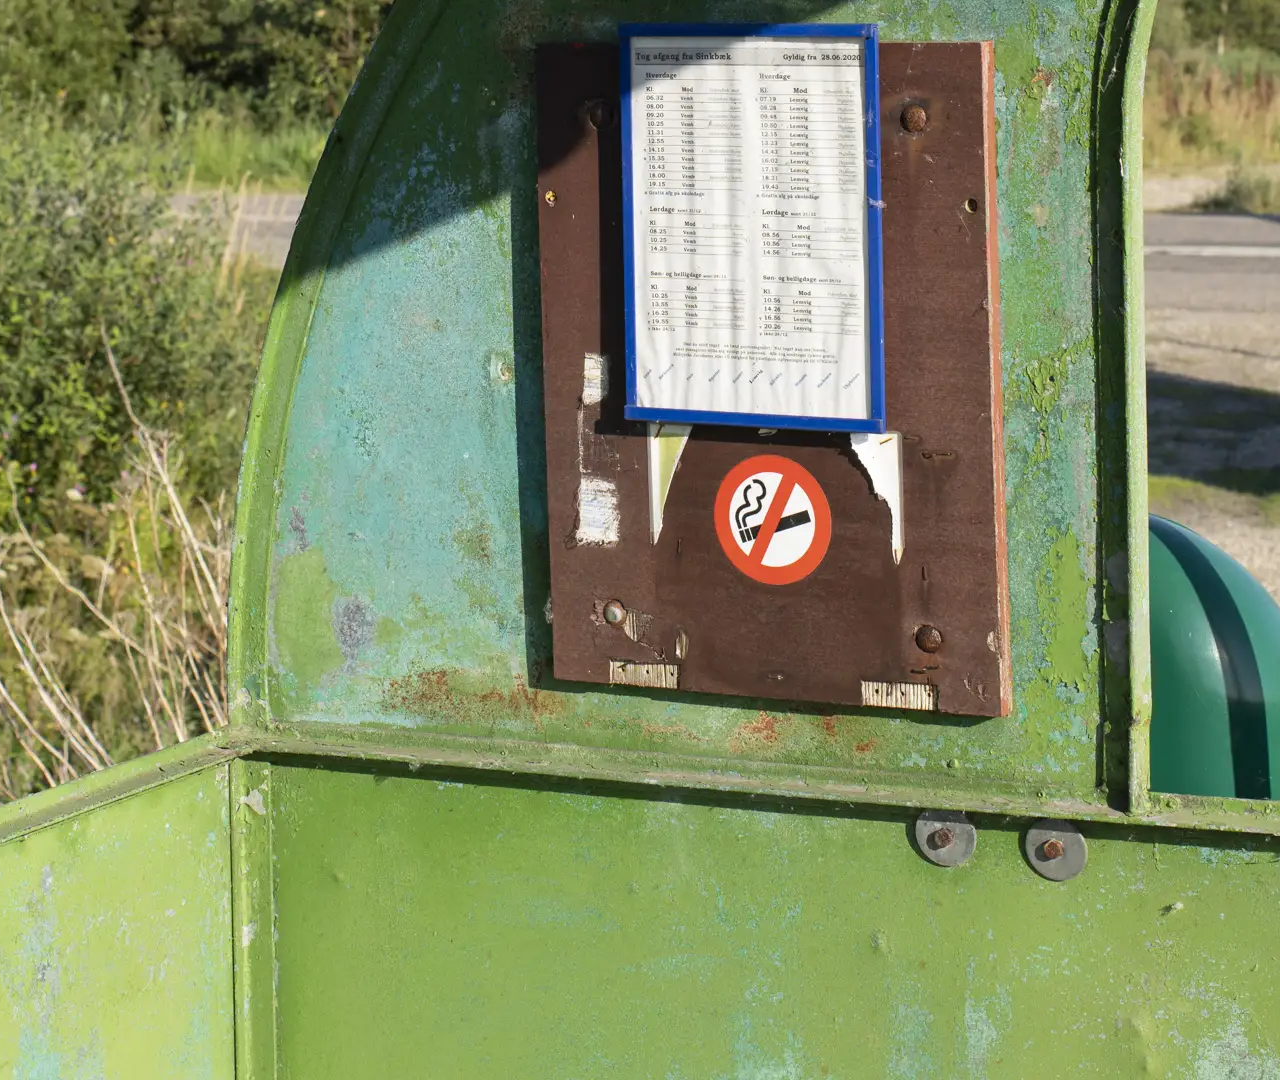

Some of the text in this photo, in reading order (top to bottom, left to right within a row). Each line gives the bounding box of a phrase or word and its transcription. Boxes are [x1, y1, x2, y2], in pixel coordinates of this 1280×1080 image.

[635, 52, 731, 61] Tog afgang fra Sinkbæk
[645, 72, 677, 80] Hverdage
[759, 73, 791, 81] Hverdage
[762, 209, 789, 217] Lørdage
